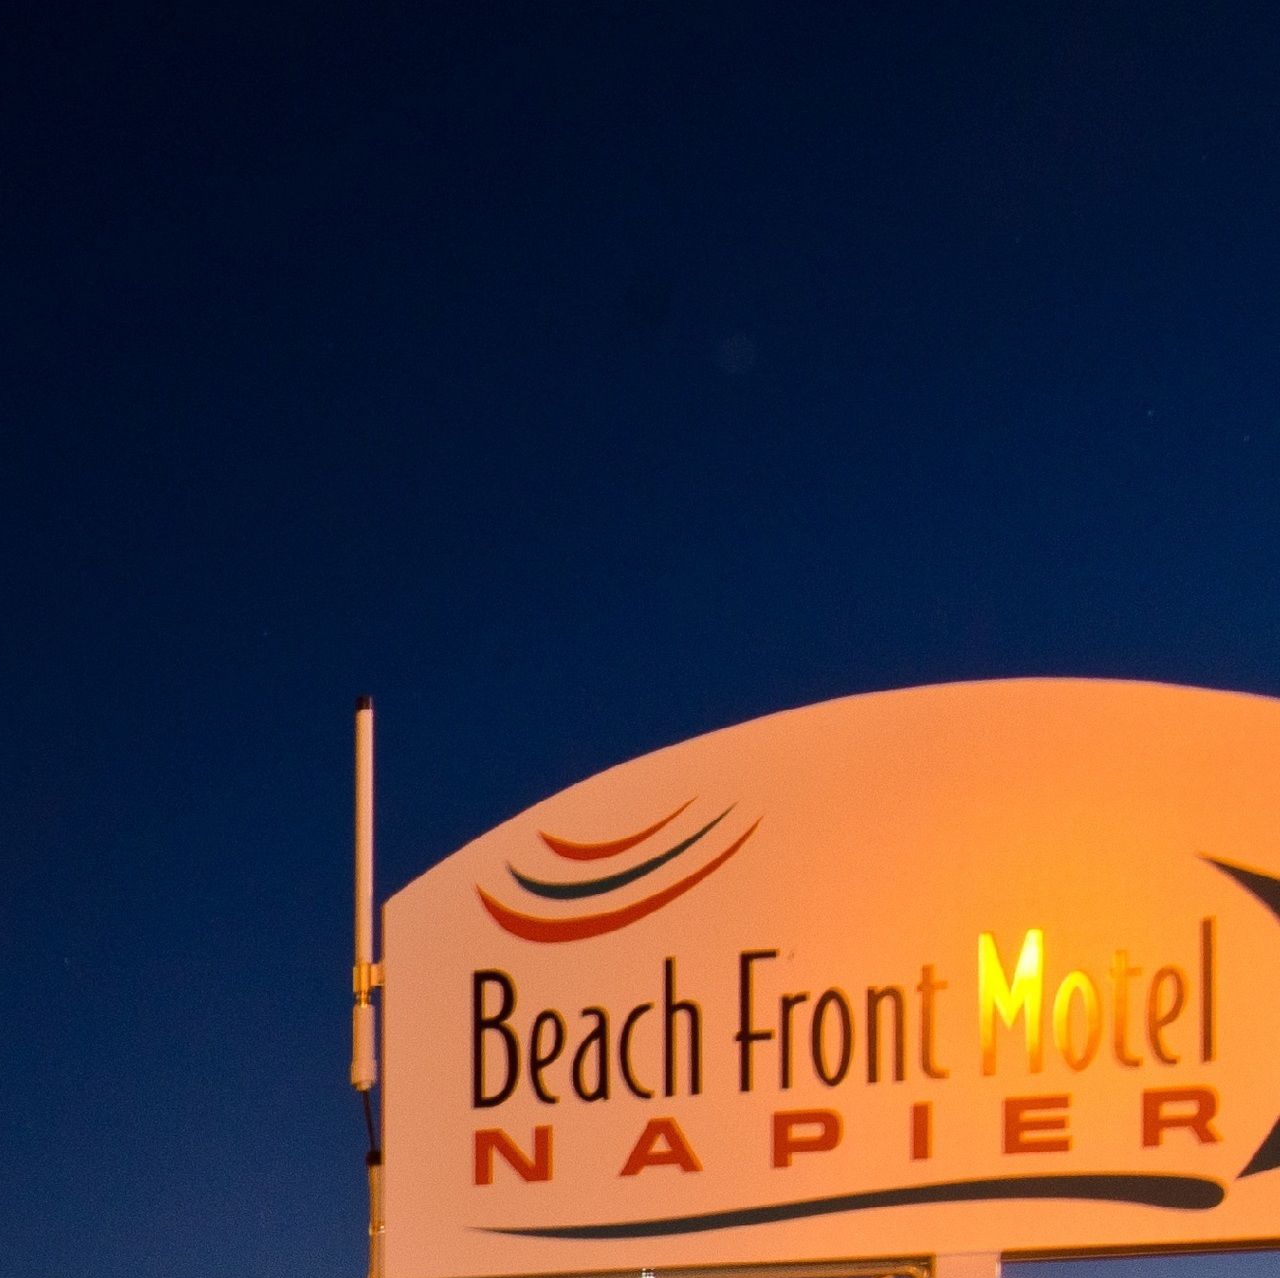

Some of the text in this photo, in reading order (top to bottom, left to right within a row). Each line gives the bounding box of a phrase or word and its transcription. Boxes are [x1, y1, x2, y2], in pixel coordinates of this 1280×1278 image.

[472, 917, 1217, 1108] Beach Front Motel
[473, 1086, 1220, 1185] NAPIER
